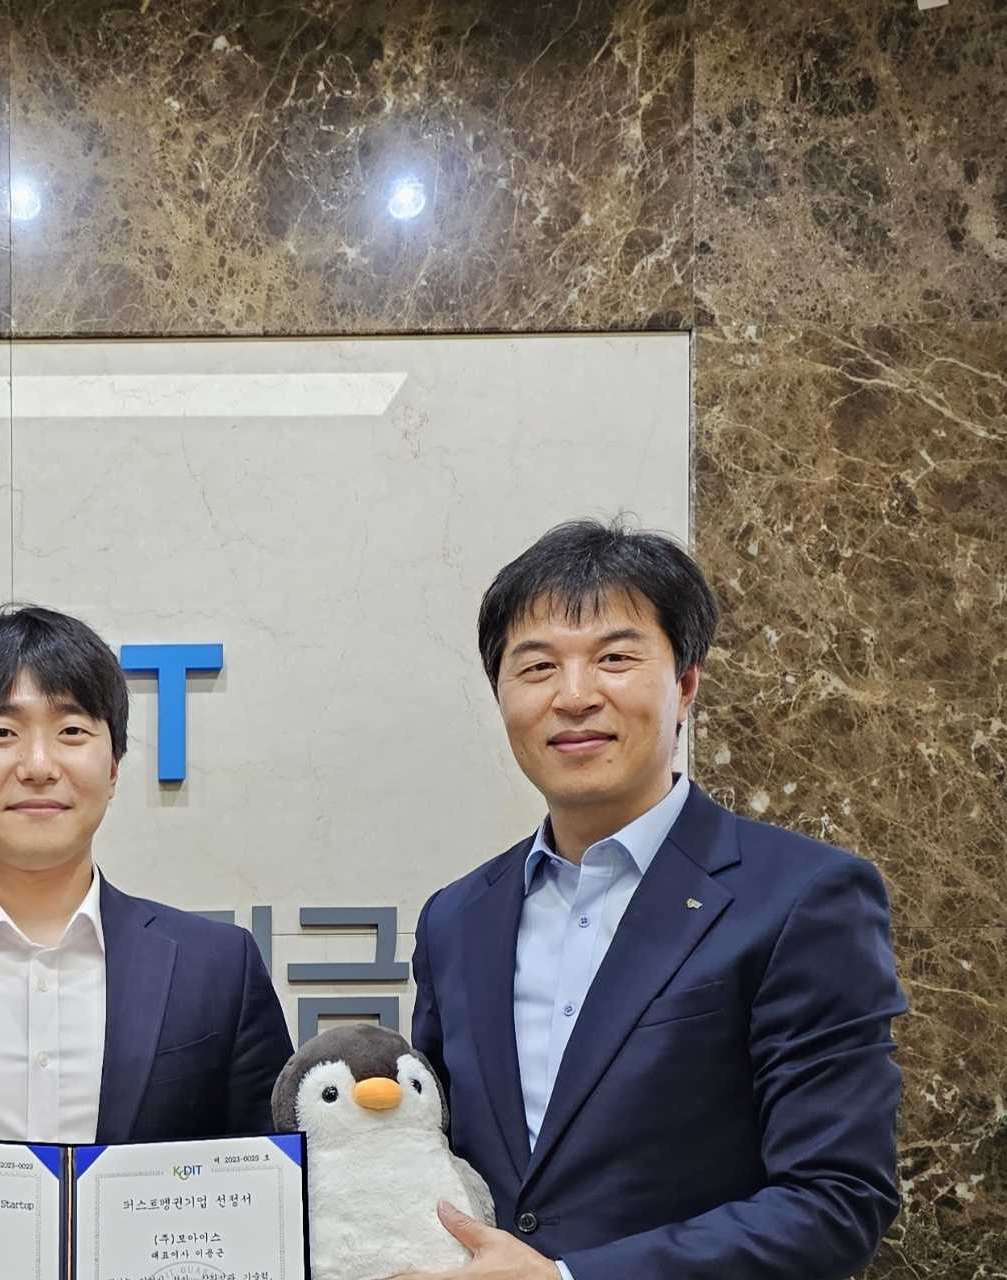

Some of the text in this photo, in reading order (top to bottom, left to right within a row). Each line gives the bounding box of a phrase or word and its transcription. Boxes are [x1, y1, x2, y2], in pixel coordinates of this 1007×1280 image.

[173, 1165, 203, 1180] KODIT
[0, 1199, 35, 1211] Startup
[217, 1192, 252, 1209] 선정서
[154, 1232, 222, 1246] (주)모아이스
[151, 1249, 190, 1261] 대표이사
